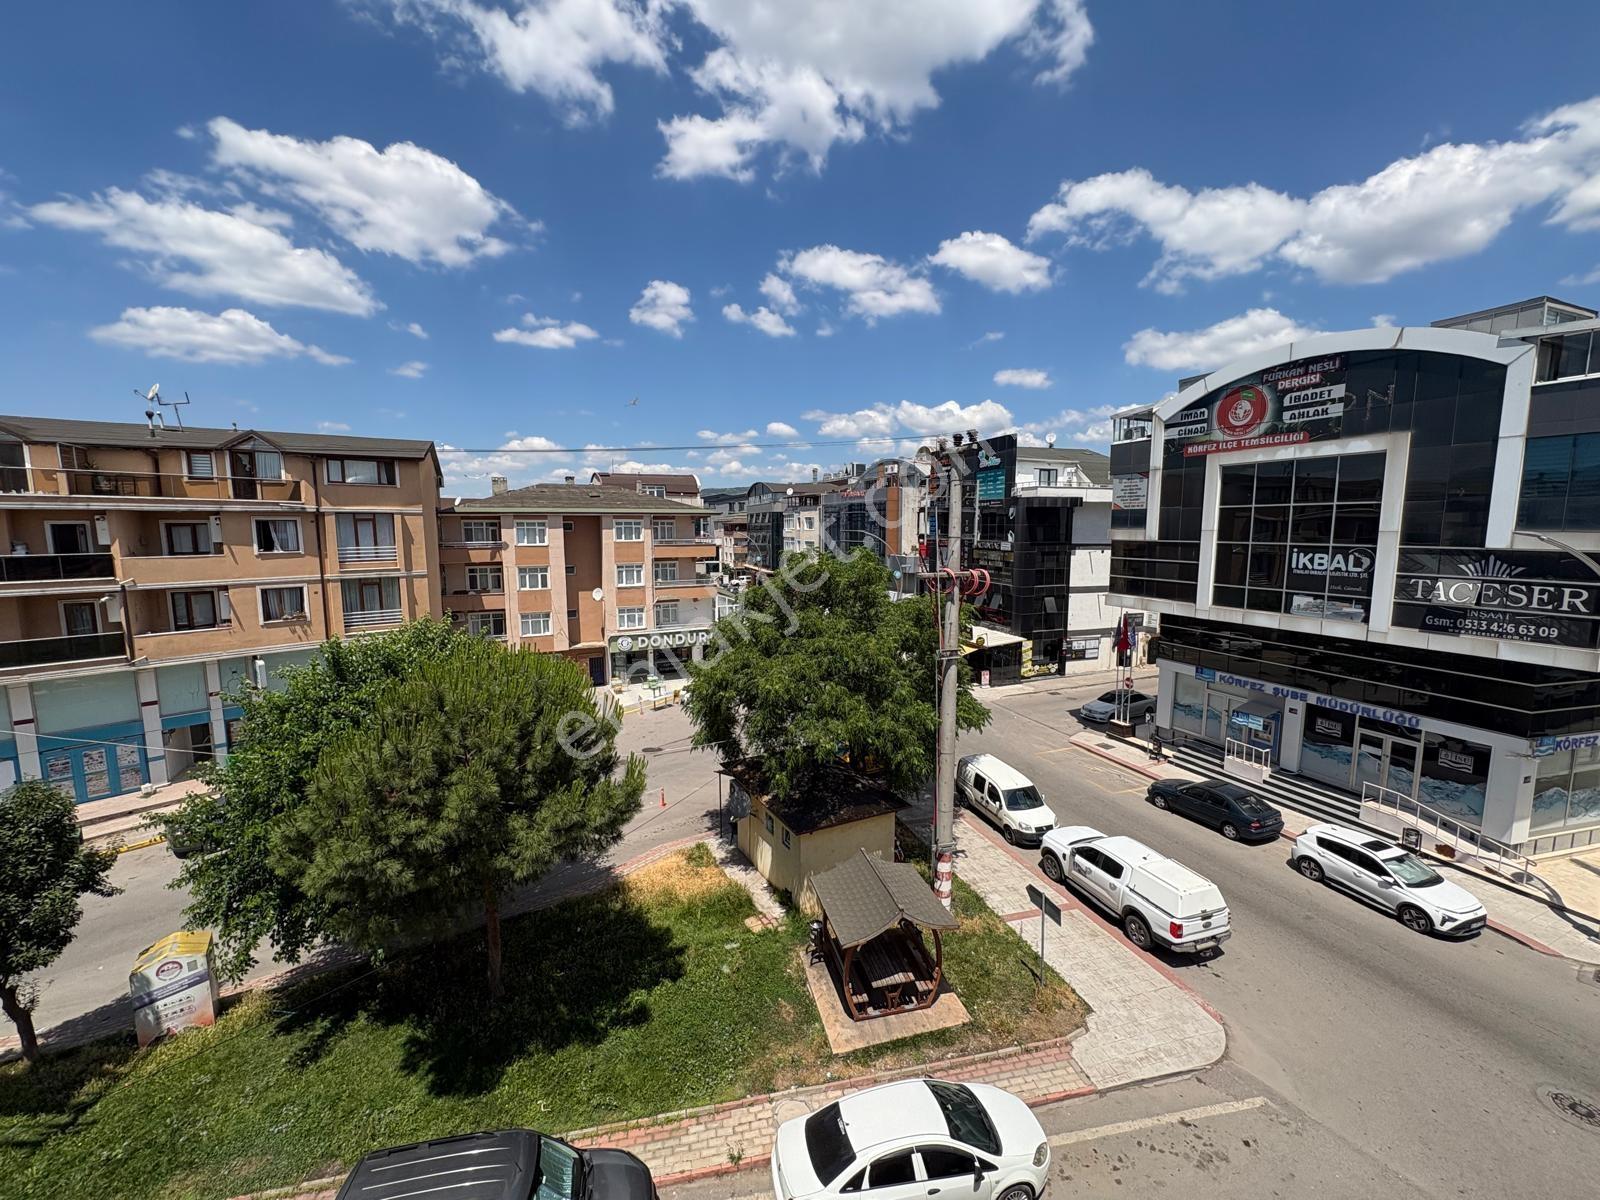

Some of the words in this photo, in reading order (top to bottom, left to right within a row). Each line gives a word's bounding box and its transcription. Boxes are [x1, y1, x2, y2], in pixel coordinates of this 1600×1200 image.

[1263, 366, 1304, 383] FURKAN
[1289, 388, 1334, 404] İBADET
[1289, 407, 1330, 421] AHLAK
[1187, 443, 1217, 454] KÖRFEZ
[1410, 578, 1590, 613] TACESER
[1425, 615, 1454, 627] Gsm:
[1457, 618, 1487, 630] 0533
[1489, 621, 1516, 634] 426
[1518, 624, 1536, 637] 63
[1539, 626, 1559, 638] 09
[1218, 674, 1265, 693] KÖRFEZ
[1272, 685, 1308, 701] ŞUBE
[1315, 694, 1421, 728] MÜDÜRLÜĞÜ
[1555, 735, 1599, 752] KÖRFEZ
